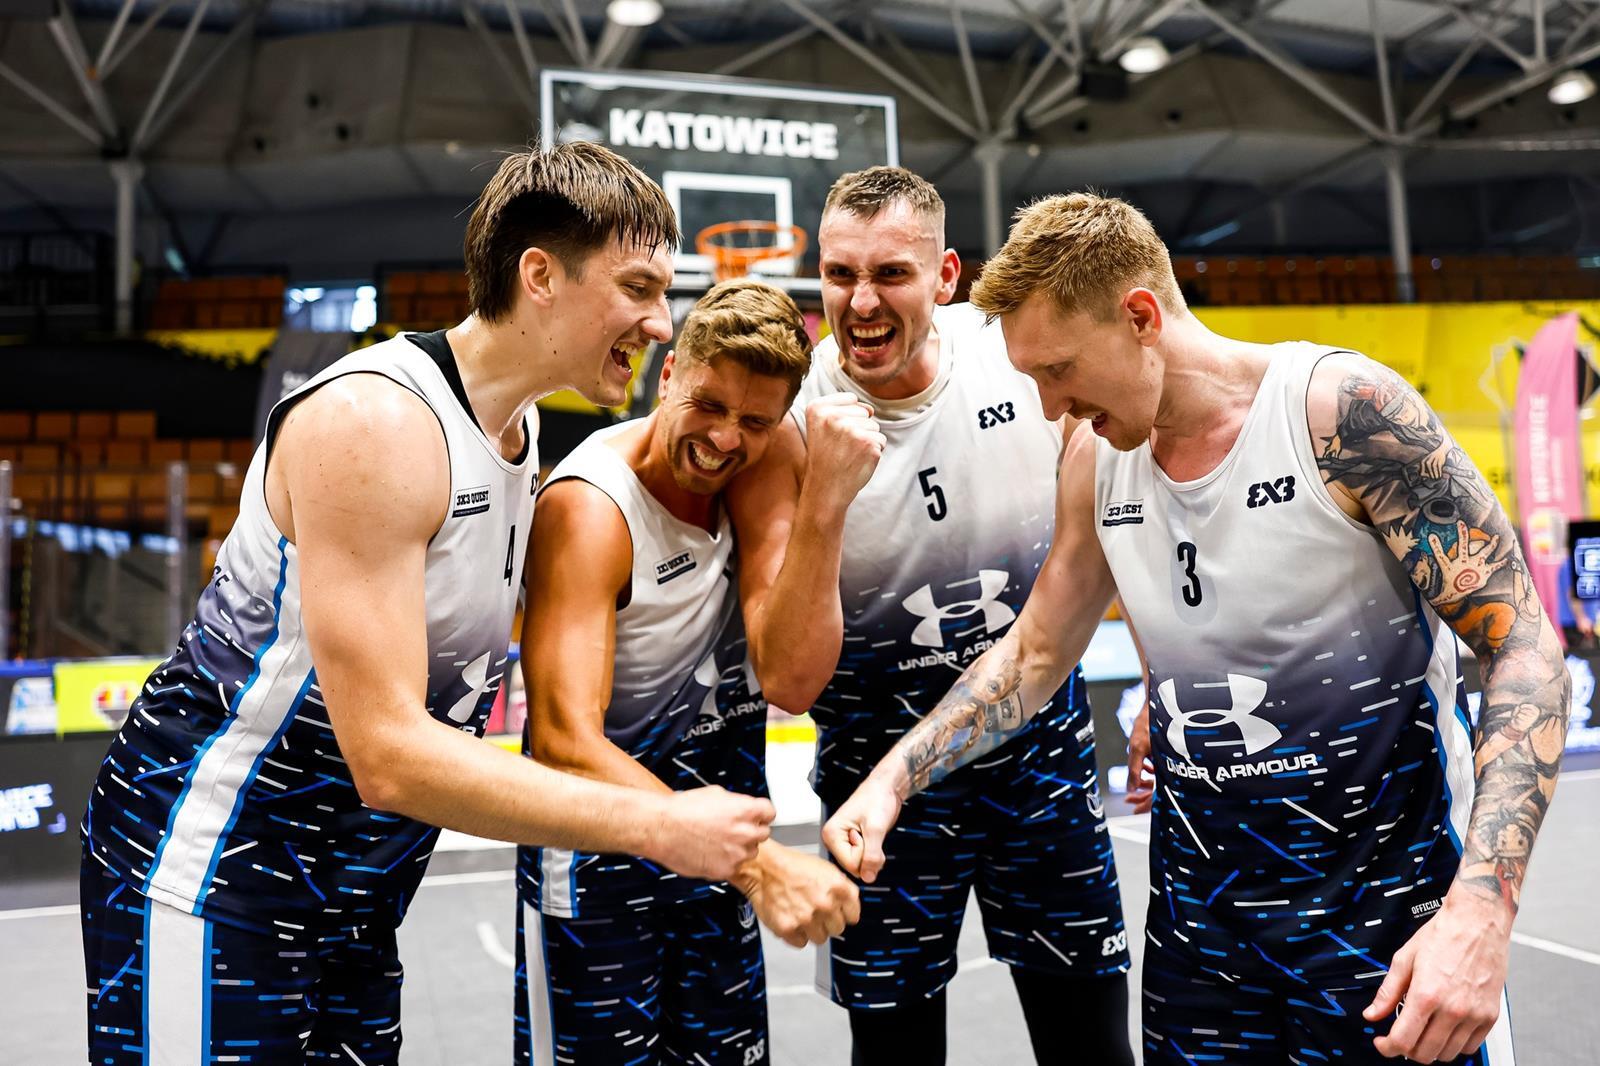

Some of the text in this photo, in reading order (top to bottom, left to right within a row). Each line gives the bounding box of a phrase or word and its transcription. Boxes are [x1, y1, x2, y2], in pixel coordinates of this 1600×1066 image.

[609, 107, 839, 160] KATOWICE
[471, 490, 489, 504] QUEST
[918, 466, 947, 522] 5
[504, 524, 516, 587] 4
[1177, 541, 1203, 607] 3
[898, 638, 1002, 671] UNDER ARM
[682, 700, 768, 742] NDE ARM
[1166, 753, 1319, 780] UNDER ARMOUR
[1411, 899, 1441, 915] OFFICIAL
